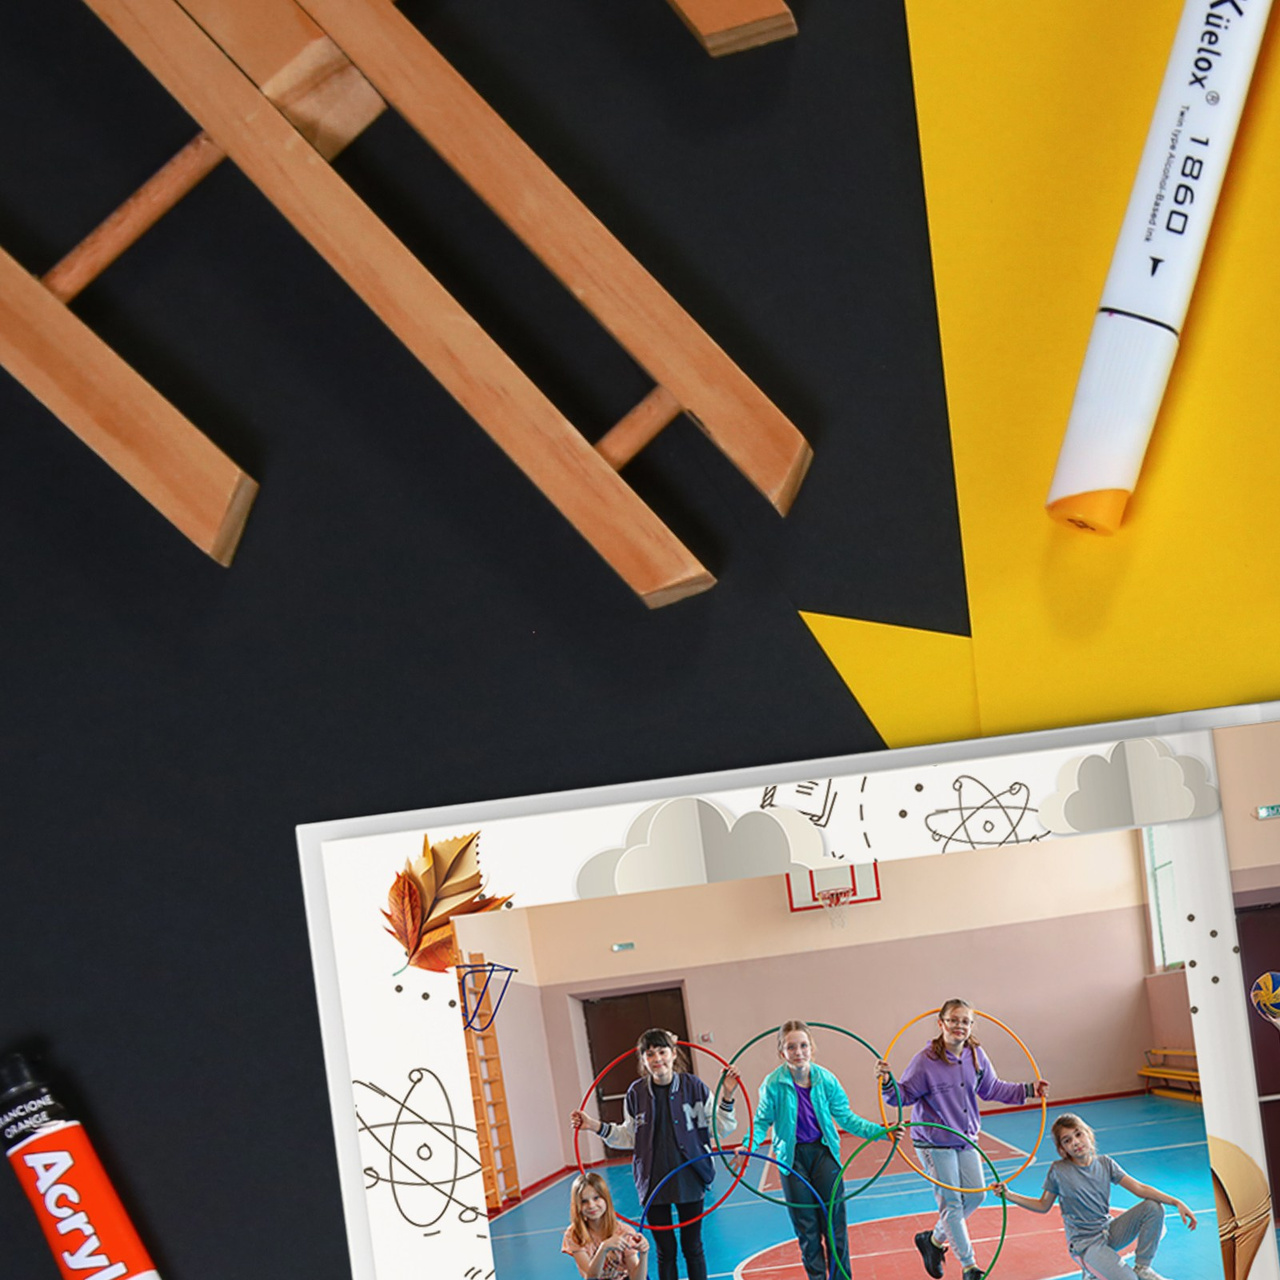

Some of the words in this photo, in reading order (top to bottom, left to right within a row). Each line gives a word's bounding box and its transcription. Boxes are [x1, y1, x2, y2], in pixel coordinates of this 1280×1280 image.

[1165, 136, 1210, 235] 1860
[4, 1110, 50, 1139] ORANGE
[682, 1101, 709, 1131] M
